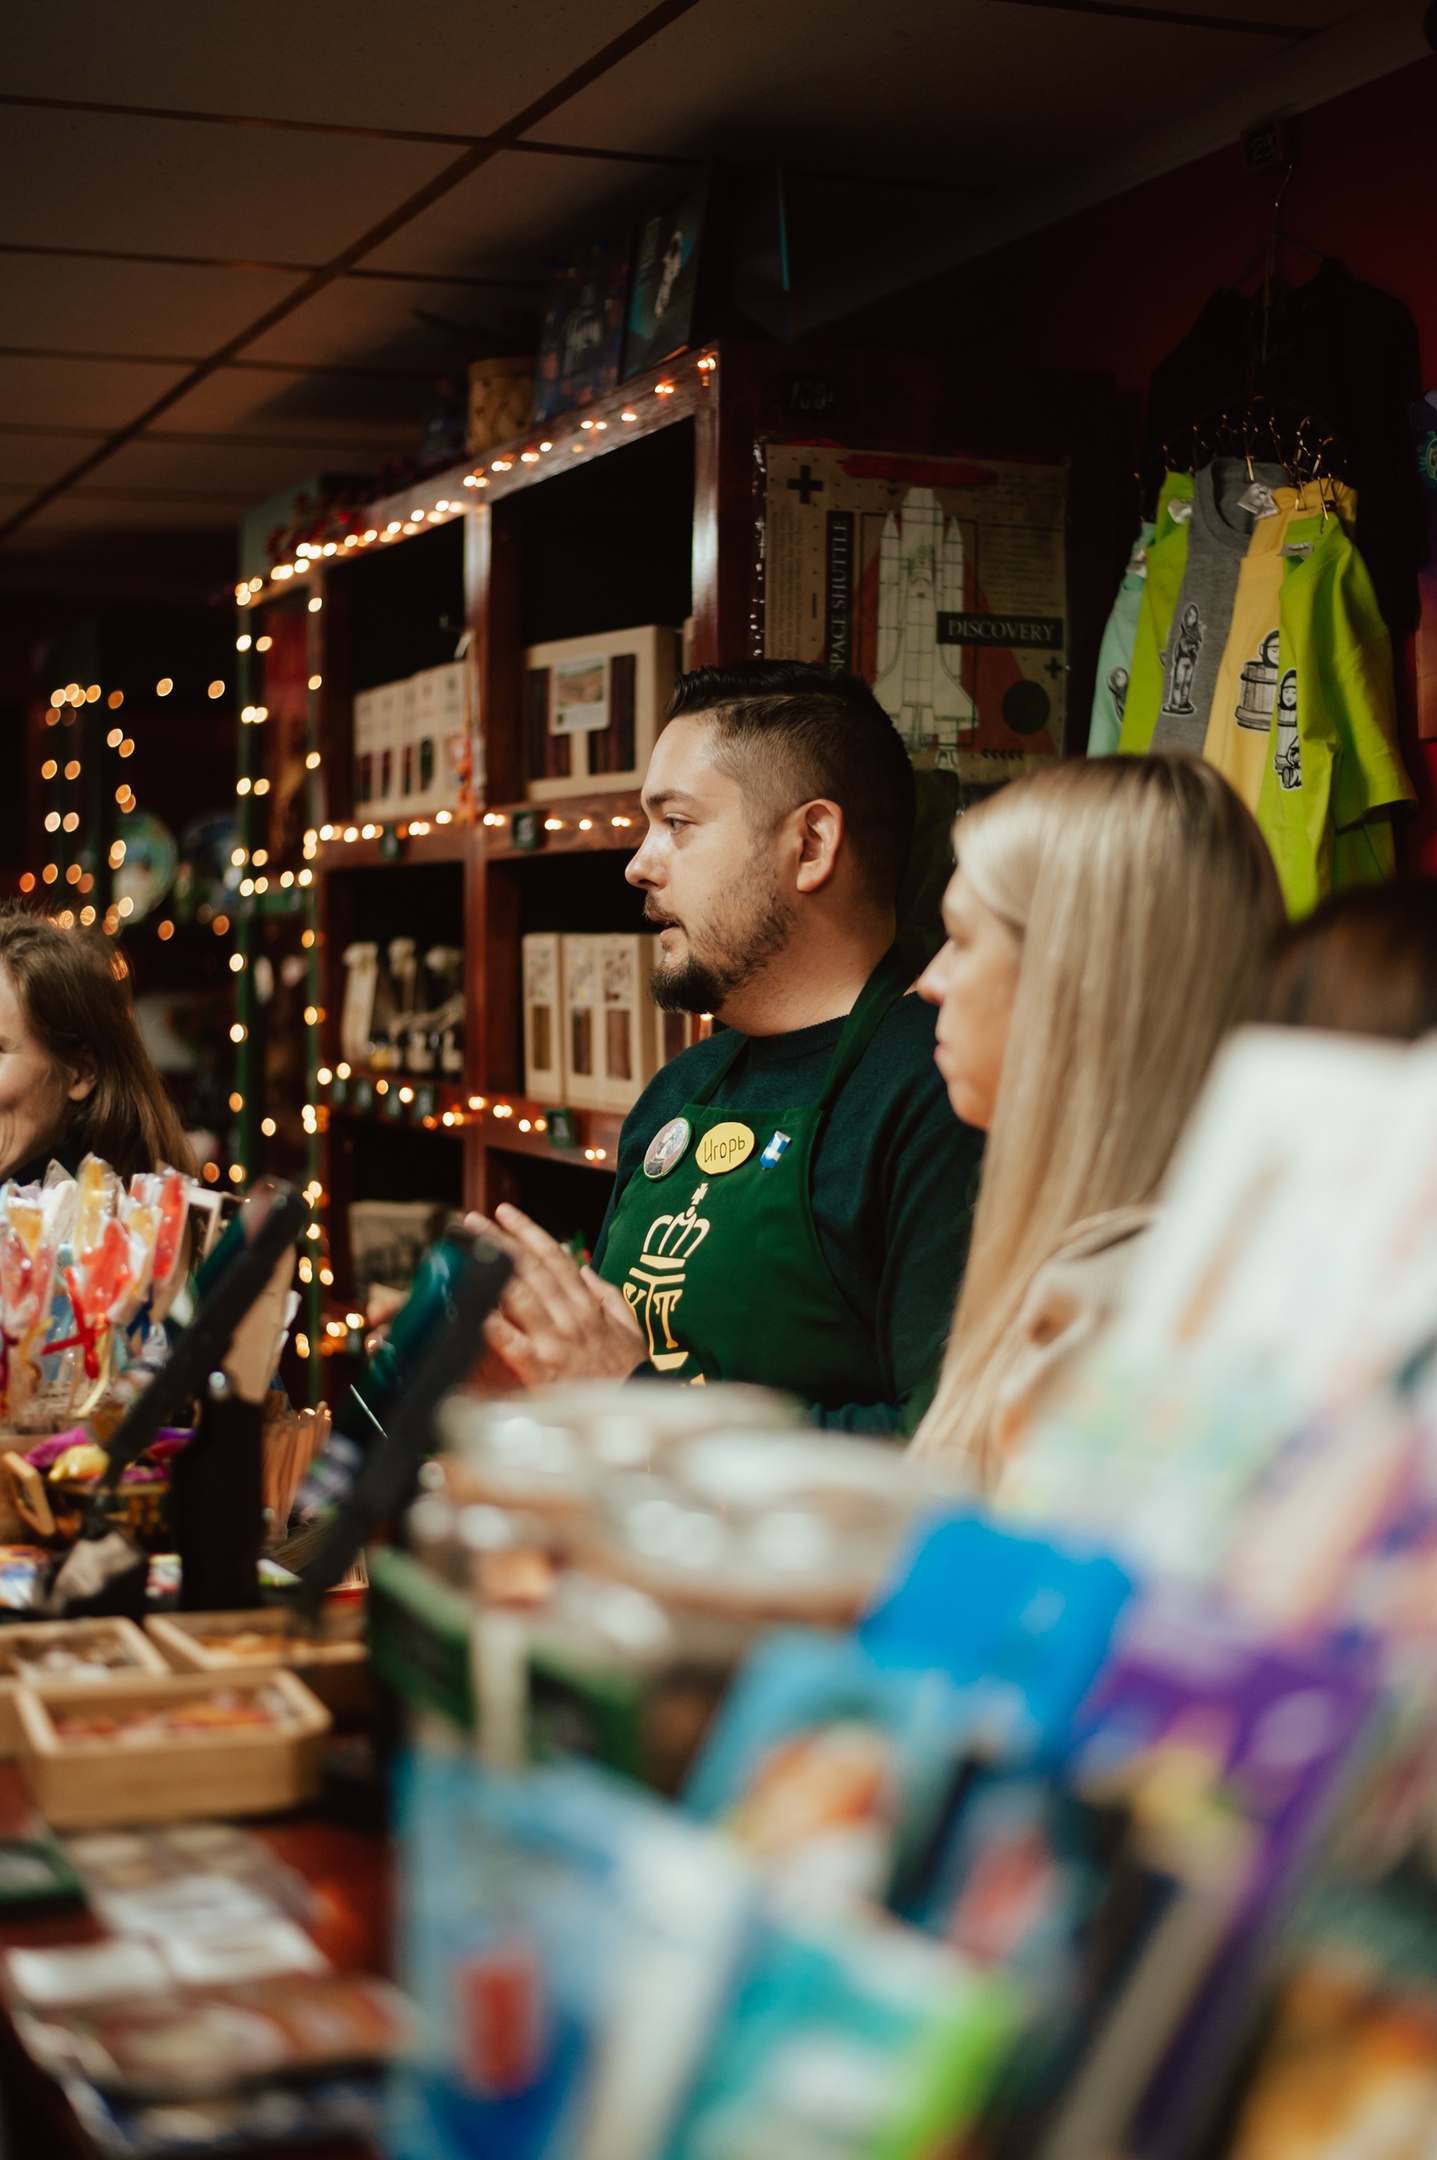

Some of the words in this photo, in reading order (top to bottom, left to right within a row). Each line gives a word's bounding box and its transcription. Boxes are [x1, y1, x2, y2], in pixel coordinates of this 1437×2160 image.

[831, 520, 848, 609] SHUTTLE
[829, 614, 846, 672] SPACE
[948, 619, 1055, 642] DISCOVERY
[704, 1135, 745, 1163] Игорь
